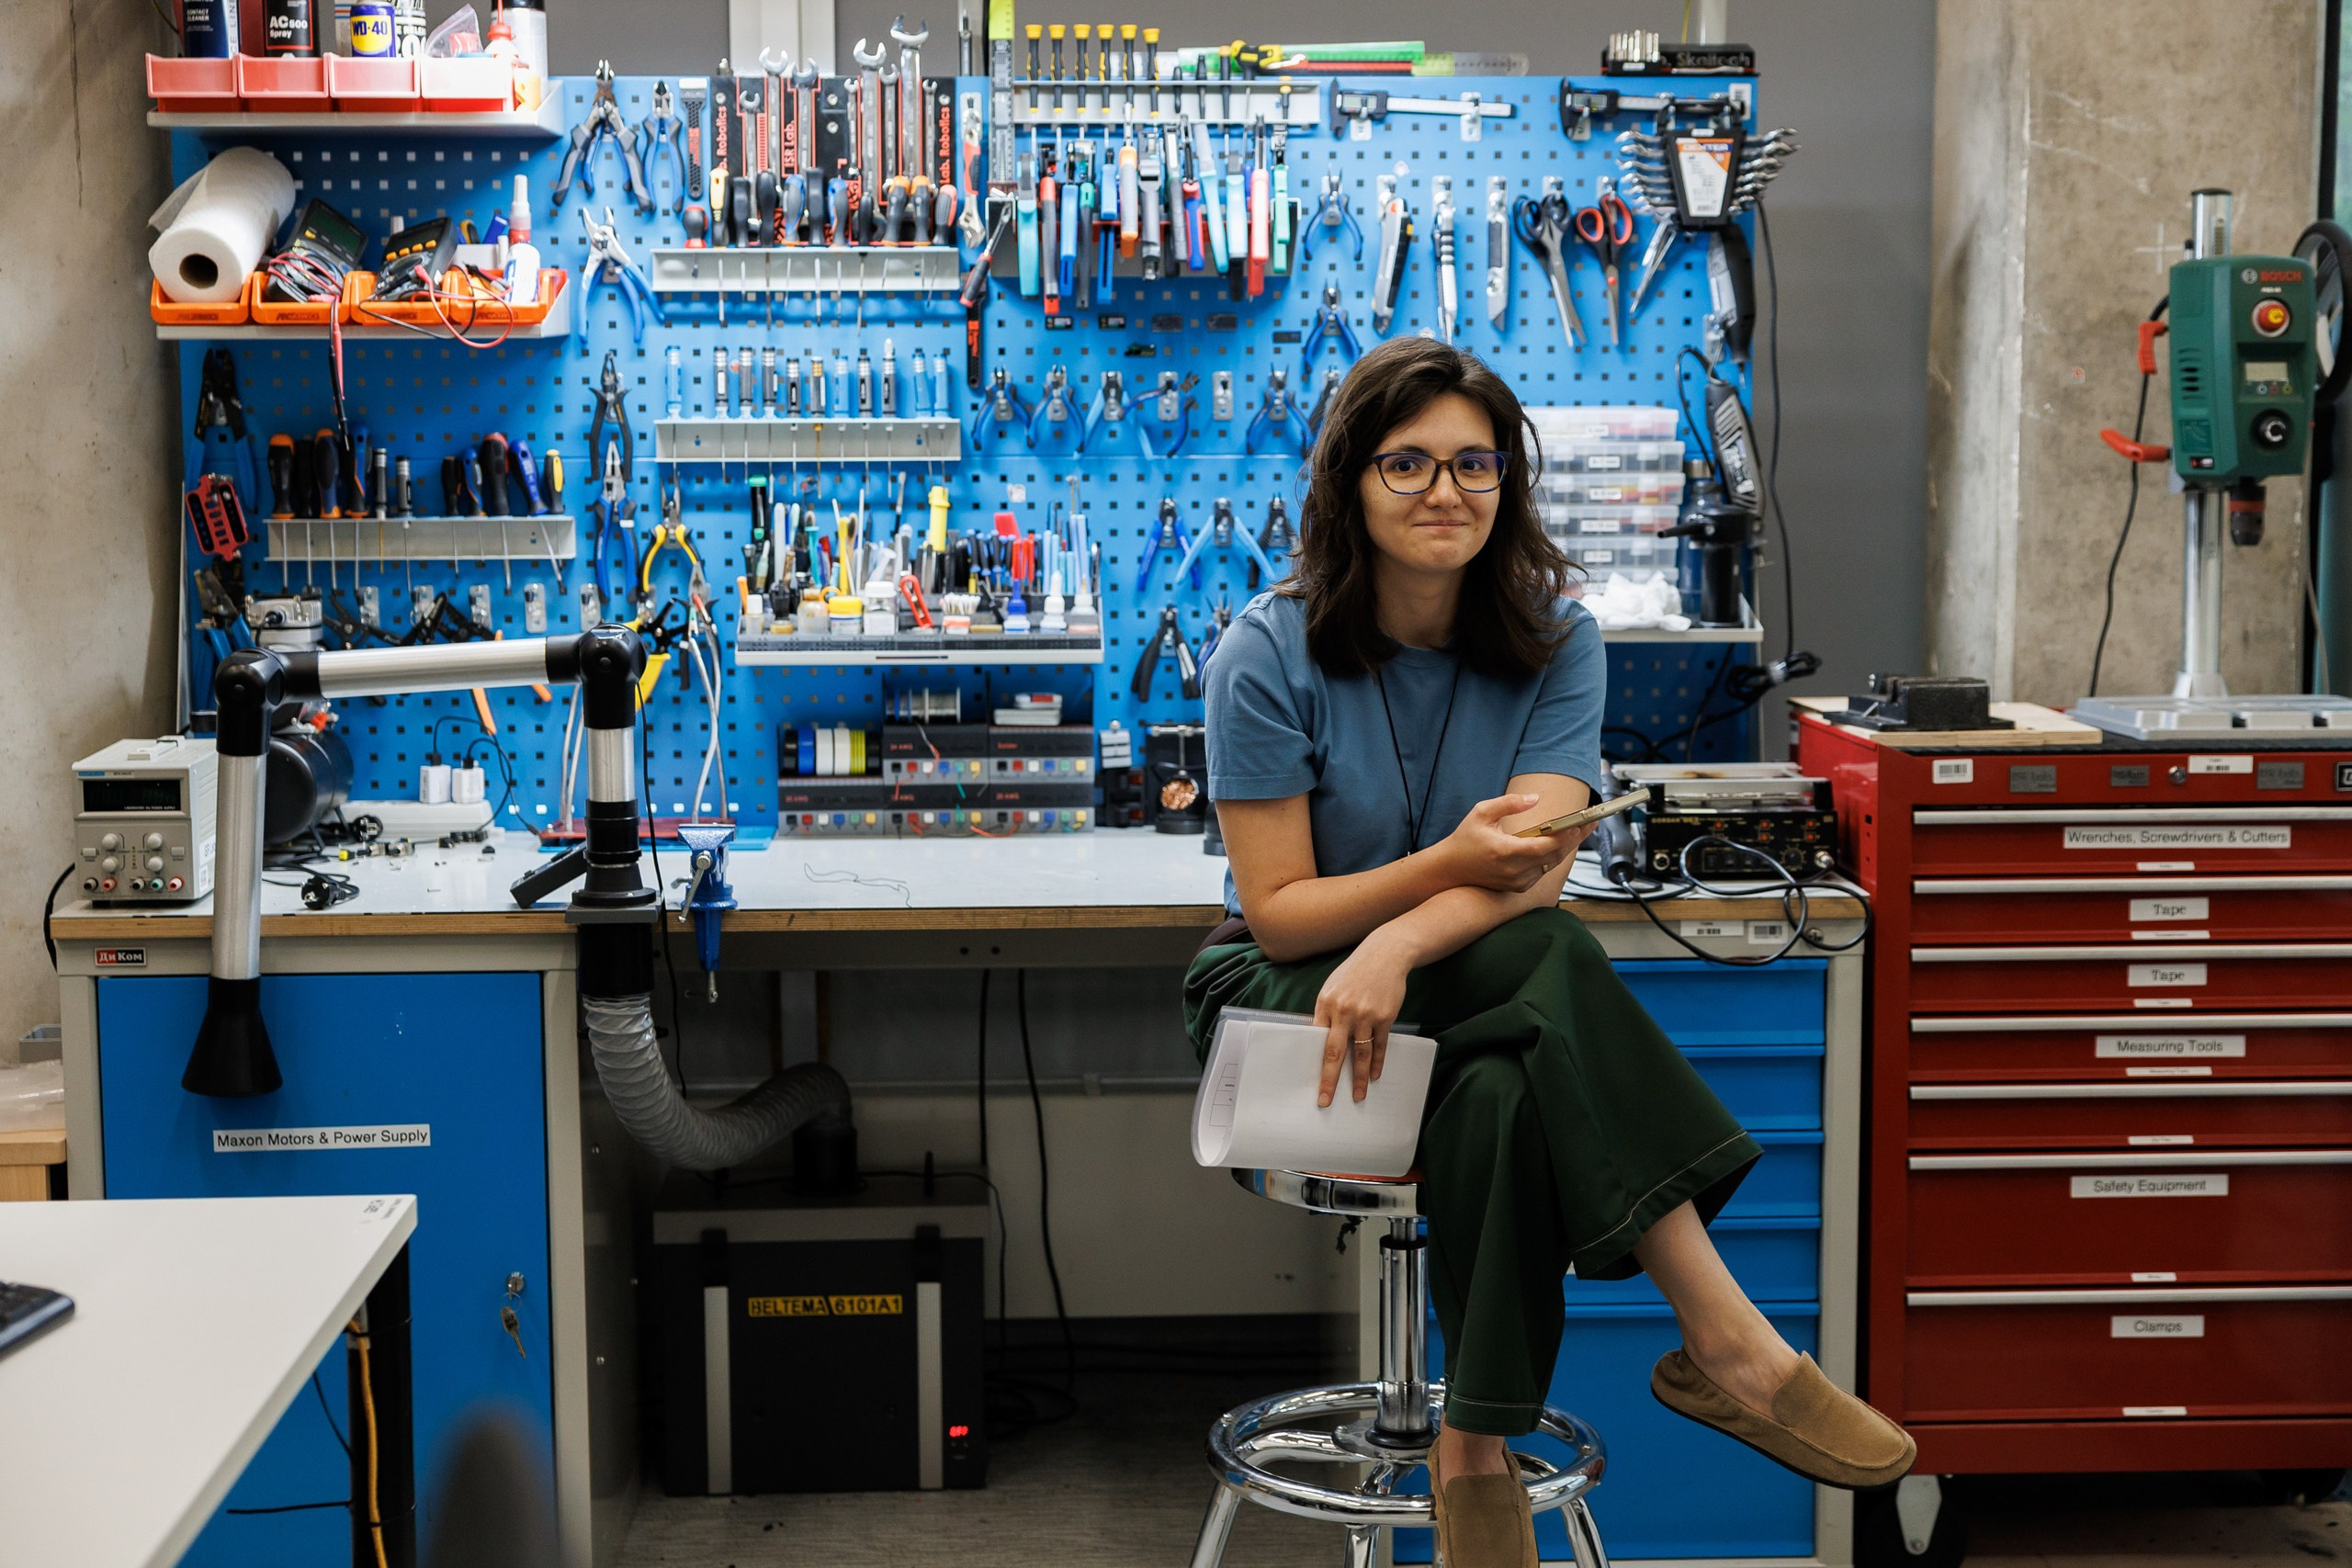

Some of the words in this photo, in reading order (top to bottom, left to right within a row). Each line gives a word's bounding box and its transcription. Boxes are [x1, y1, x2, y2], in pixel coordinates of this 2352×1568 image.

[269, 29, 292, 39] Spray
[716, 106, 728, 157] Robotics
[784, 120, 795, 147] Lab.
[938, 107, 951, 157] Robotics
[784, 148, 795, 167] ISR
[2260, 270, 2301, 282] BOSCH
[2068, 830, 2136, 844] Wrenches,
[2141, 829, 2223, 844] Screwdrivers
[2228, 829, 2237, 843] &
[2242, 829, 2289, 843] Cutters
[2153, 903, 2187, 917] Tape
[98, 952, 142, 963] ДиКом
[2152, 969, 2186, 983] Tape
[2117, 1040, 2184, 1054] Measuring
[2188, 1040, 2223, 1053] Tools
[217, 1134, 263, 1147] Maxon
[268, 1133, 314, 1145] Motors
[319, 1133, 329, 1145] &
[334, 1131, 377, 1144] Power
[380, 1129, 428, 1145] Supply
[2093, 1179, 2134, 1194] Safety
[2138, 1179, 2207, 1193] Equipment
[834, 1297, 901, 1314] 6101A1
[2133, 1320, 2184, 1333] Clamps
